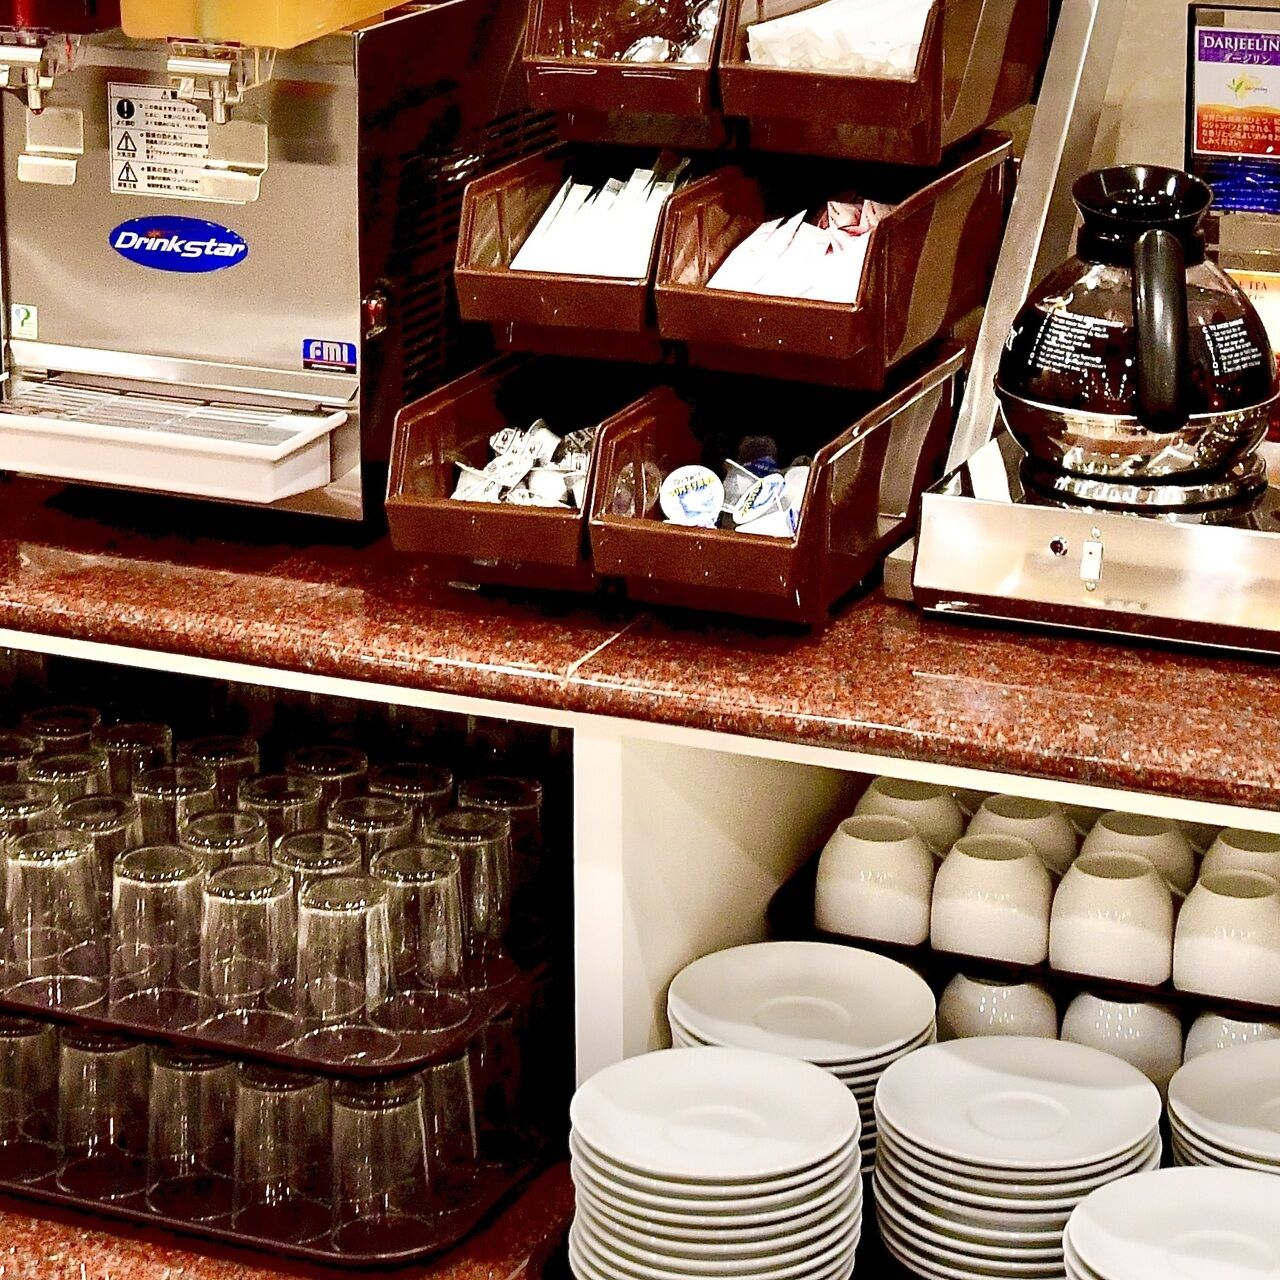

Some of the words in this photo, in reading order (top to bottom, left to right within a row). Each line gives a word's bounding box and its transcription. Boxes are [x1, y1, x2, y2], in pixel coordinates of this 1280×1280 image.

[1223, 53, 1272, 65] ダージリン
[114, 231, 245, 258] Drinkstar
